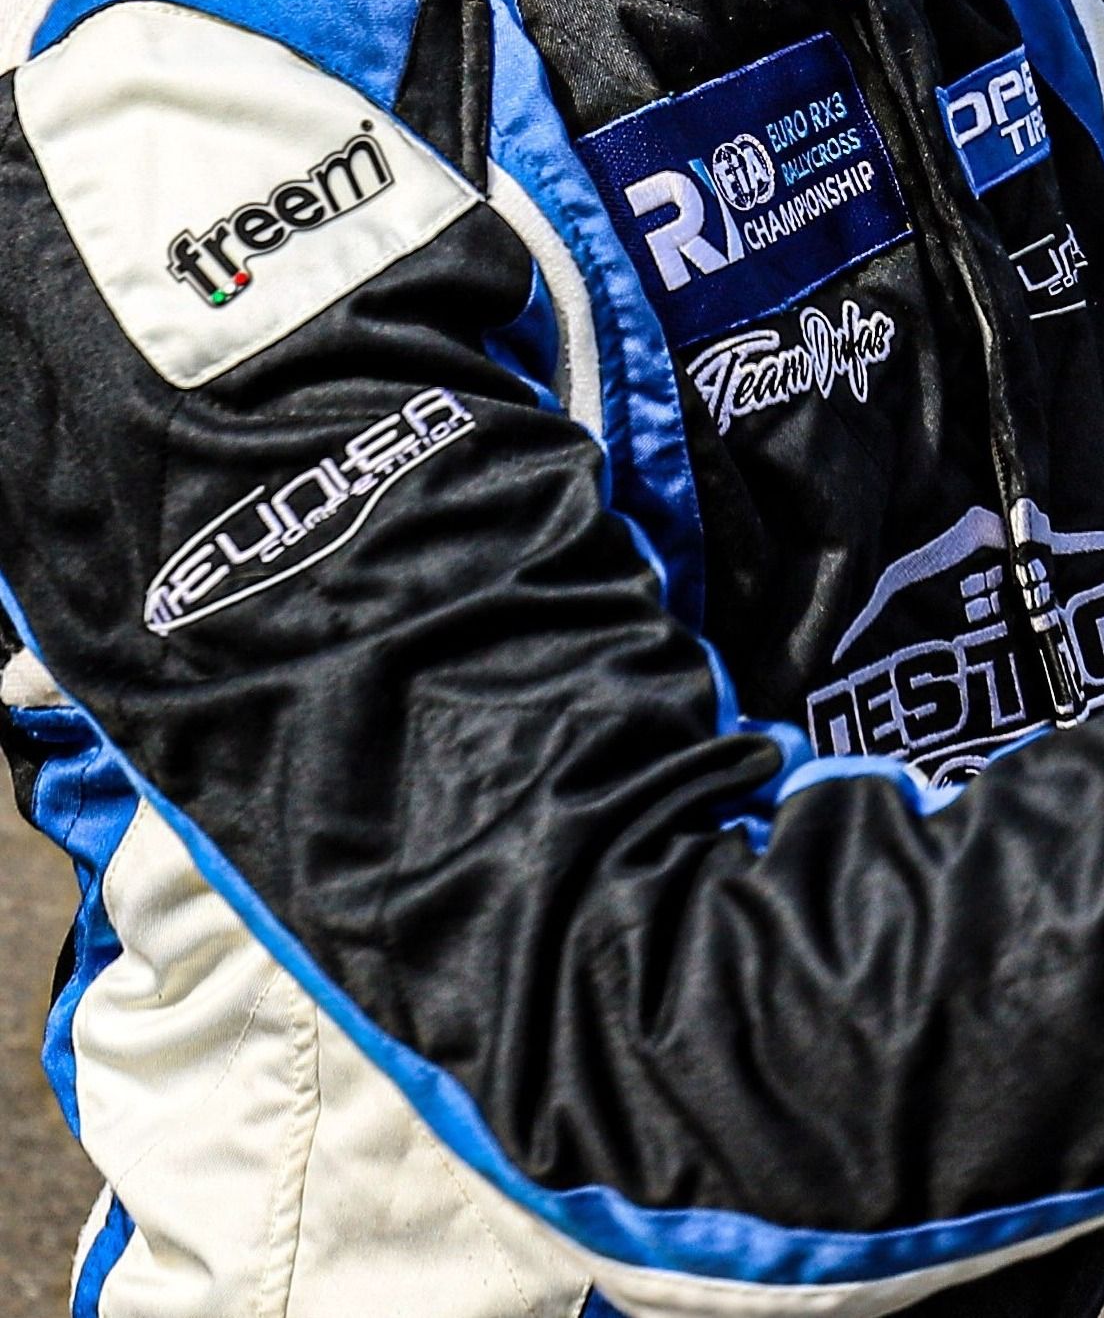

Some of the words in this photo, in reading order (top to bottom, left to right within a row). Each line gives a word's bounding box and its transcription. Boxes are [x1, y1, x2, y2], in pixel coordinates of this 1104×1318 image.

[766, 109, 808, 154] EURO
[809, 92, 848, 132] RX3
[781, 128, 861, 187] RALLYCROSS
[169, 135, 393, 302] freem
[743, 160, 876, 251] CHAMPIONSHIP
